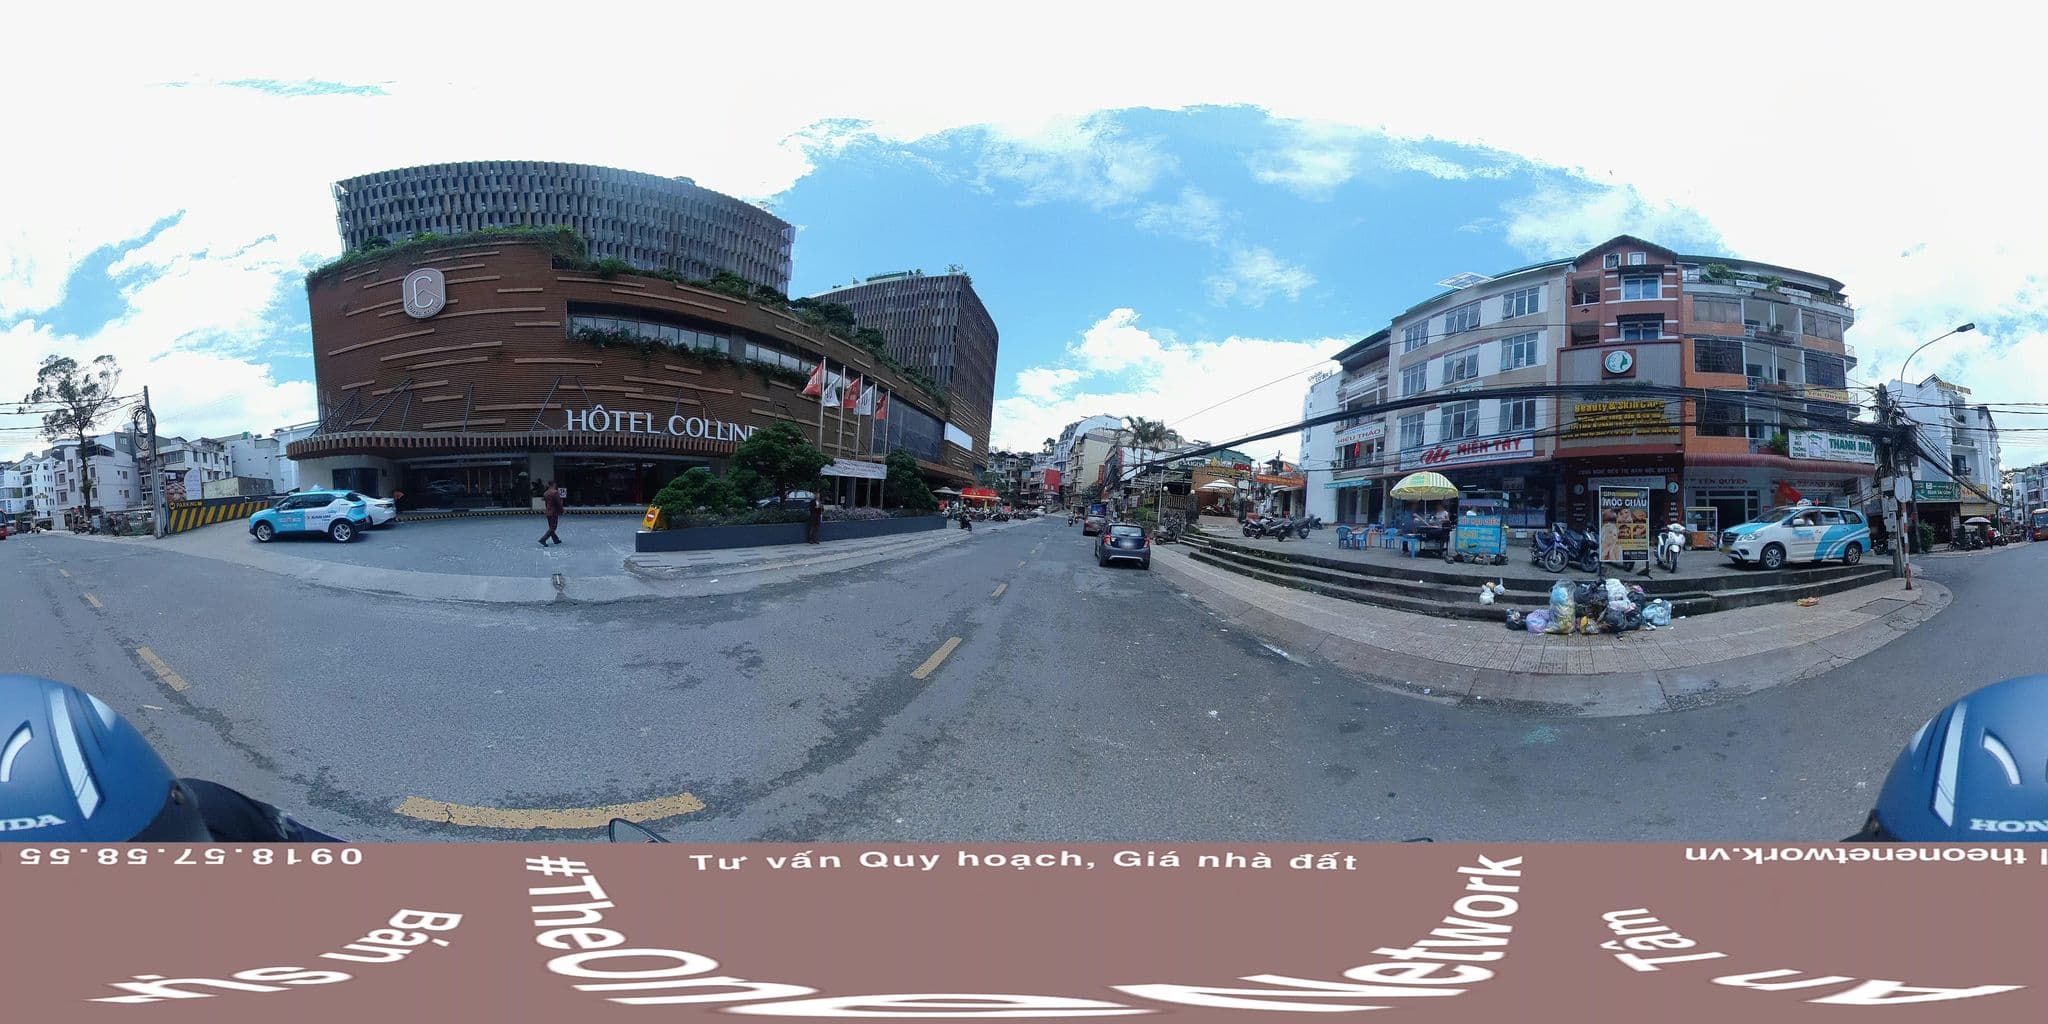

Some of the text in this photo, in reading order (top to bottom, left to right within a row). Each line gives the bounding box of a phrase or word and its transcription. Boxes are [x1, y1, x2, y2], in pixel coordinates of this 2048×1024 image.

[1574, 402, 1607, 414] Beauty
[1608, 401, 1616, 411] &
[1618, 400, 1639, 410] Skin
[566, 404, 661, 434] HÔTEL
[1829, 438, 1857, 450] THANH
